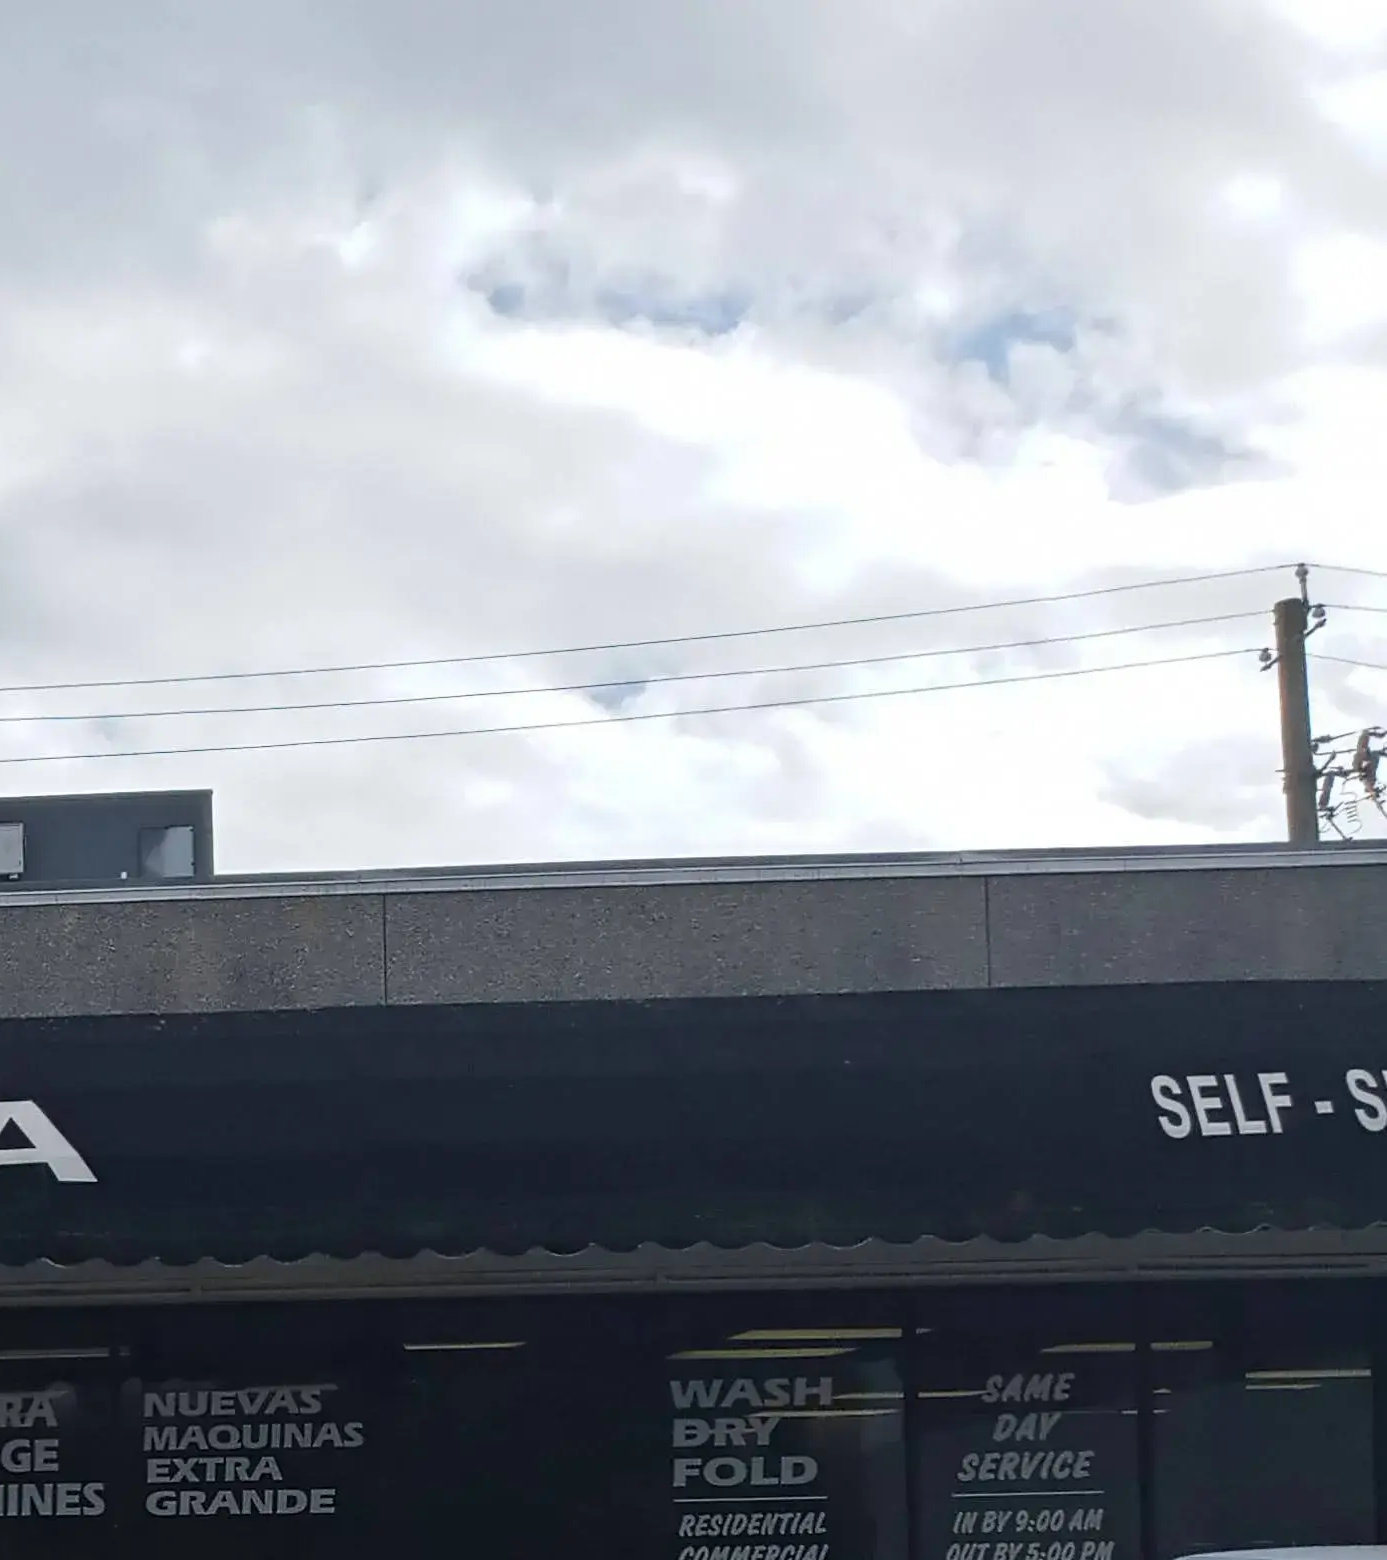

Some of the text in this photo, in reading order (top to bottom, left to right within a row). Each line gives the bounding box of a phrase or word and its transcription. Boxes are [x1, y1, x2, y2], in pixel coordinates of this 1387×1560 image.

[1150, 1072, 1293, 1138] SELF
[1345, 1067, 1387, 1132] S
[143, 1387, 322, 1418] NUEVAS
[670, 1376, 833, 1409] WASH
[982, 1373, 1075, 1402] SAME
[143, 1421, 365, 1452] MAQUINAS
[672, 1417, 780, 1448] DRY
[993, 1412, 1060, 1442] DAY
[146, 1456, 284, 1484] EXTRA
[672, 1456, 818, 1488] FOLD
[957, 1450, 1095, 1482] SERVICE
[145, 1487, 336, 1517] GRANDE
[678, 1512, 828, 1538] RESIDENTIAL
[953, 1509, 1103, 1534] IN BY 9:00 AM
